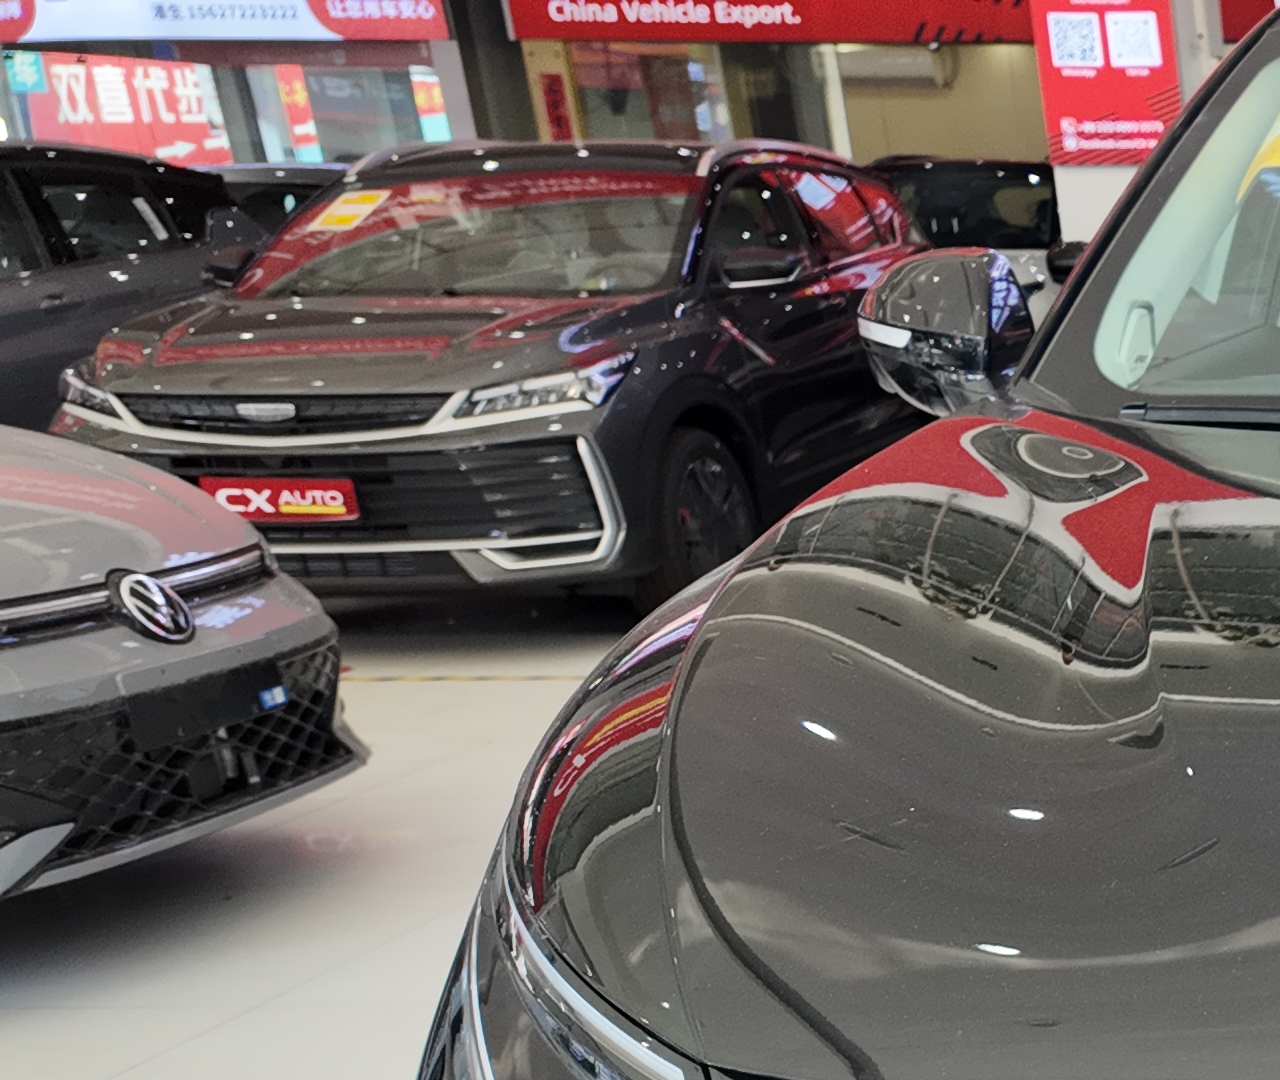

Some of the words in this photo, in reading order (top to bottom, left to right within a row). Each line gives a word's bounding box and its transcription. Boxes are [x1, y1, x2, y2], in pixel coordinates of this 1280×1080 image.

[548, 0, 618, 22] China
[621, 0, 710, 24] Vehicle
[714, 0, 801, 28] Export.
[214, 487, 276, 513] CX
[278, 489, 344, 507] AUTO
